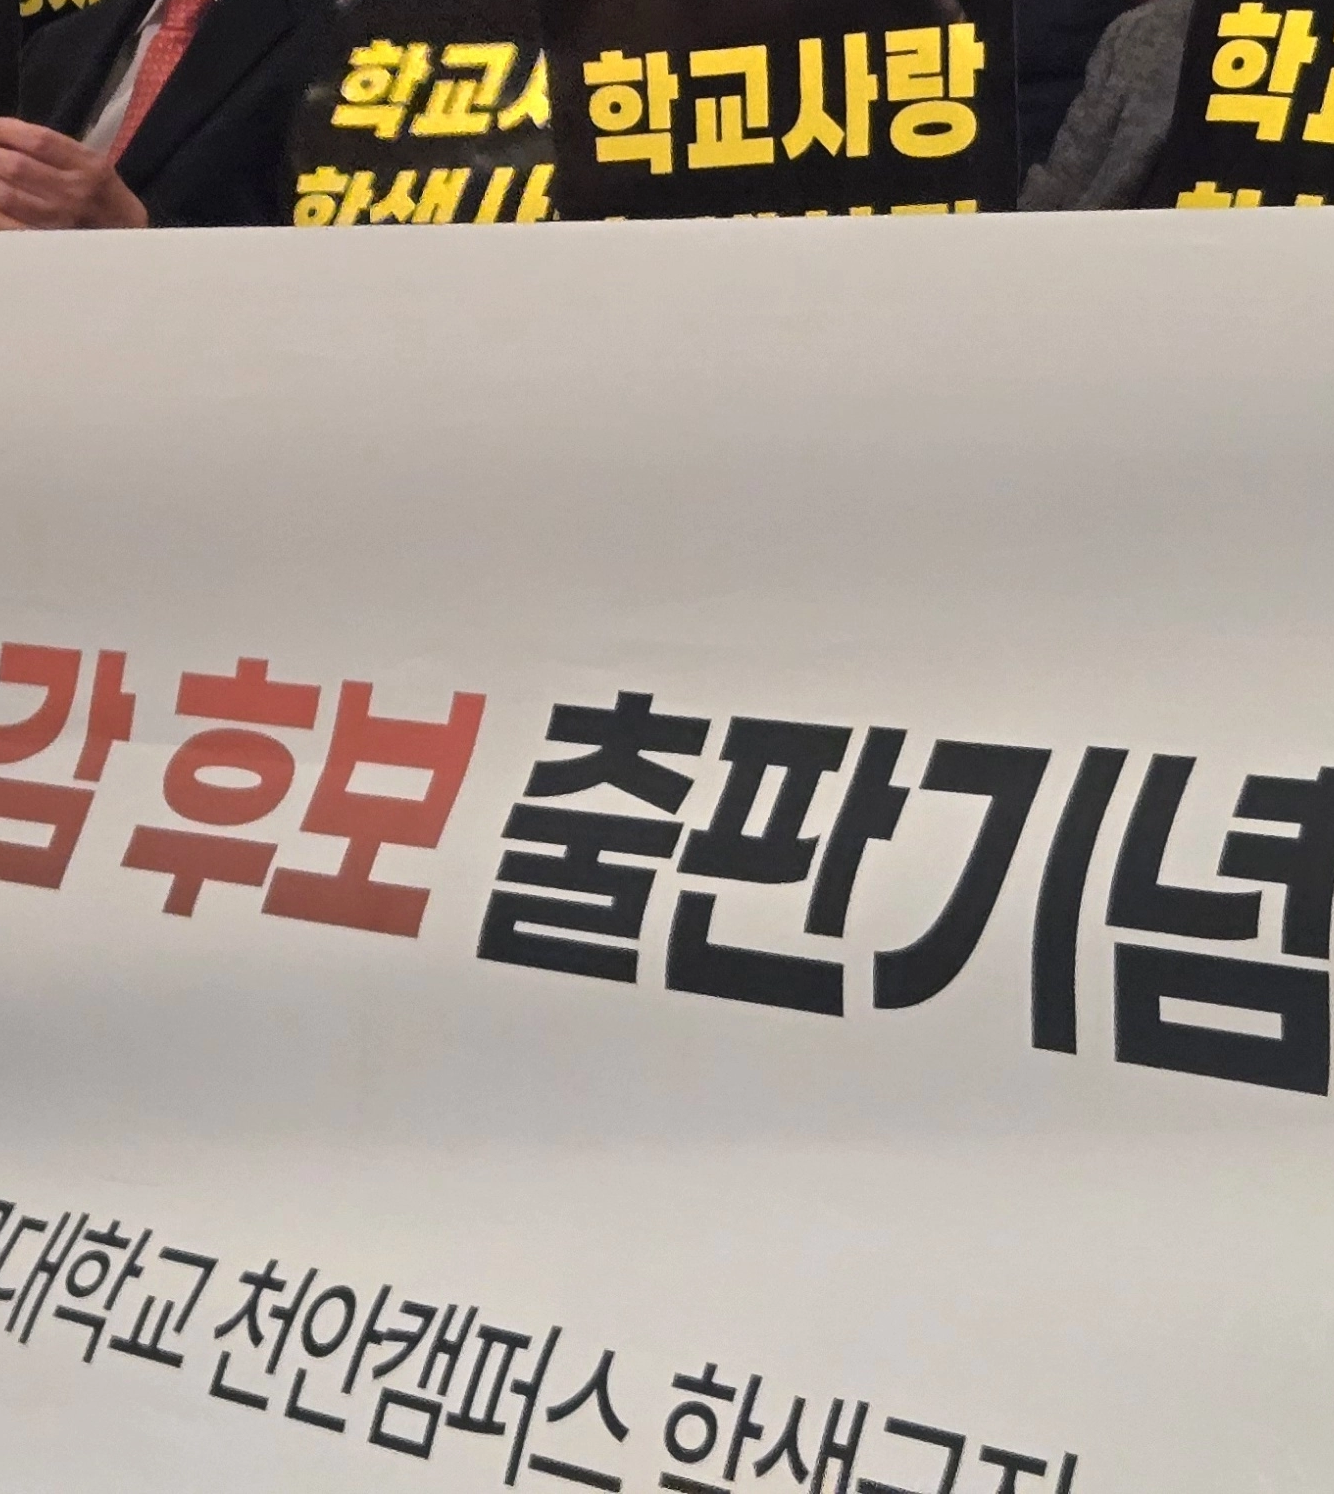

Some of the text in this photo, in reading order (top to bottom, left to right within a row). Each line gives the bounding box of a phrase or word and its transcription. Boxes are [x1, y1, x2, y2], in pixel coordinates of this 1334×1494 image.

[583, 21, 985, 175] 학교사랑
[121, 656, 486, 939] 후보
[208, 1257, 630, 1493] 천안캠퍼스
